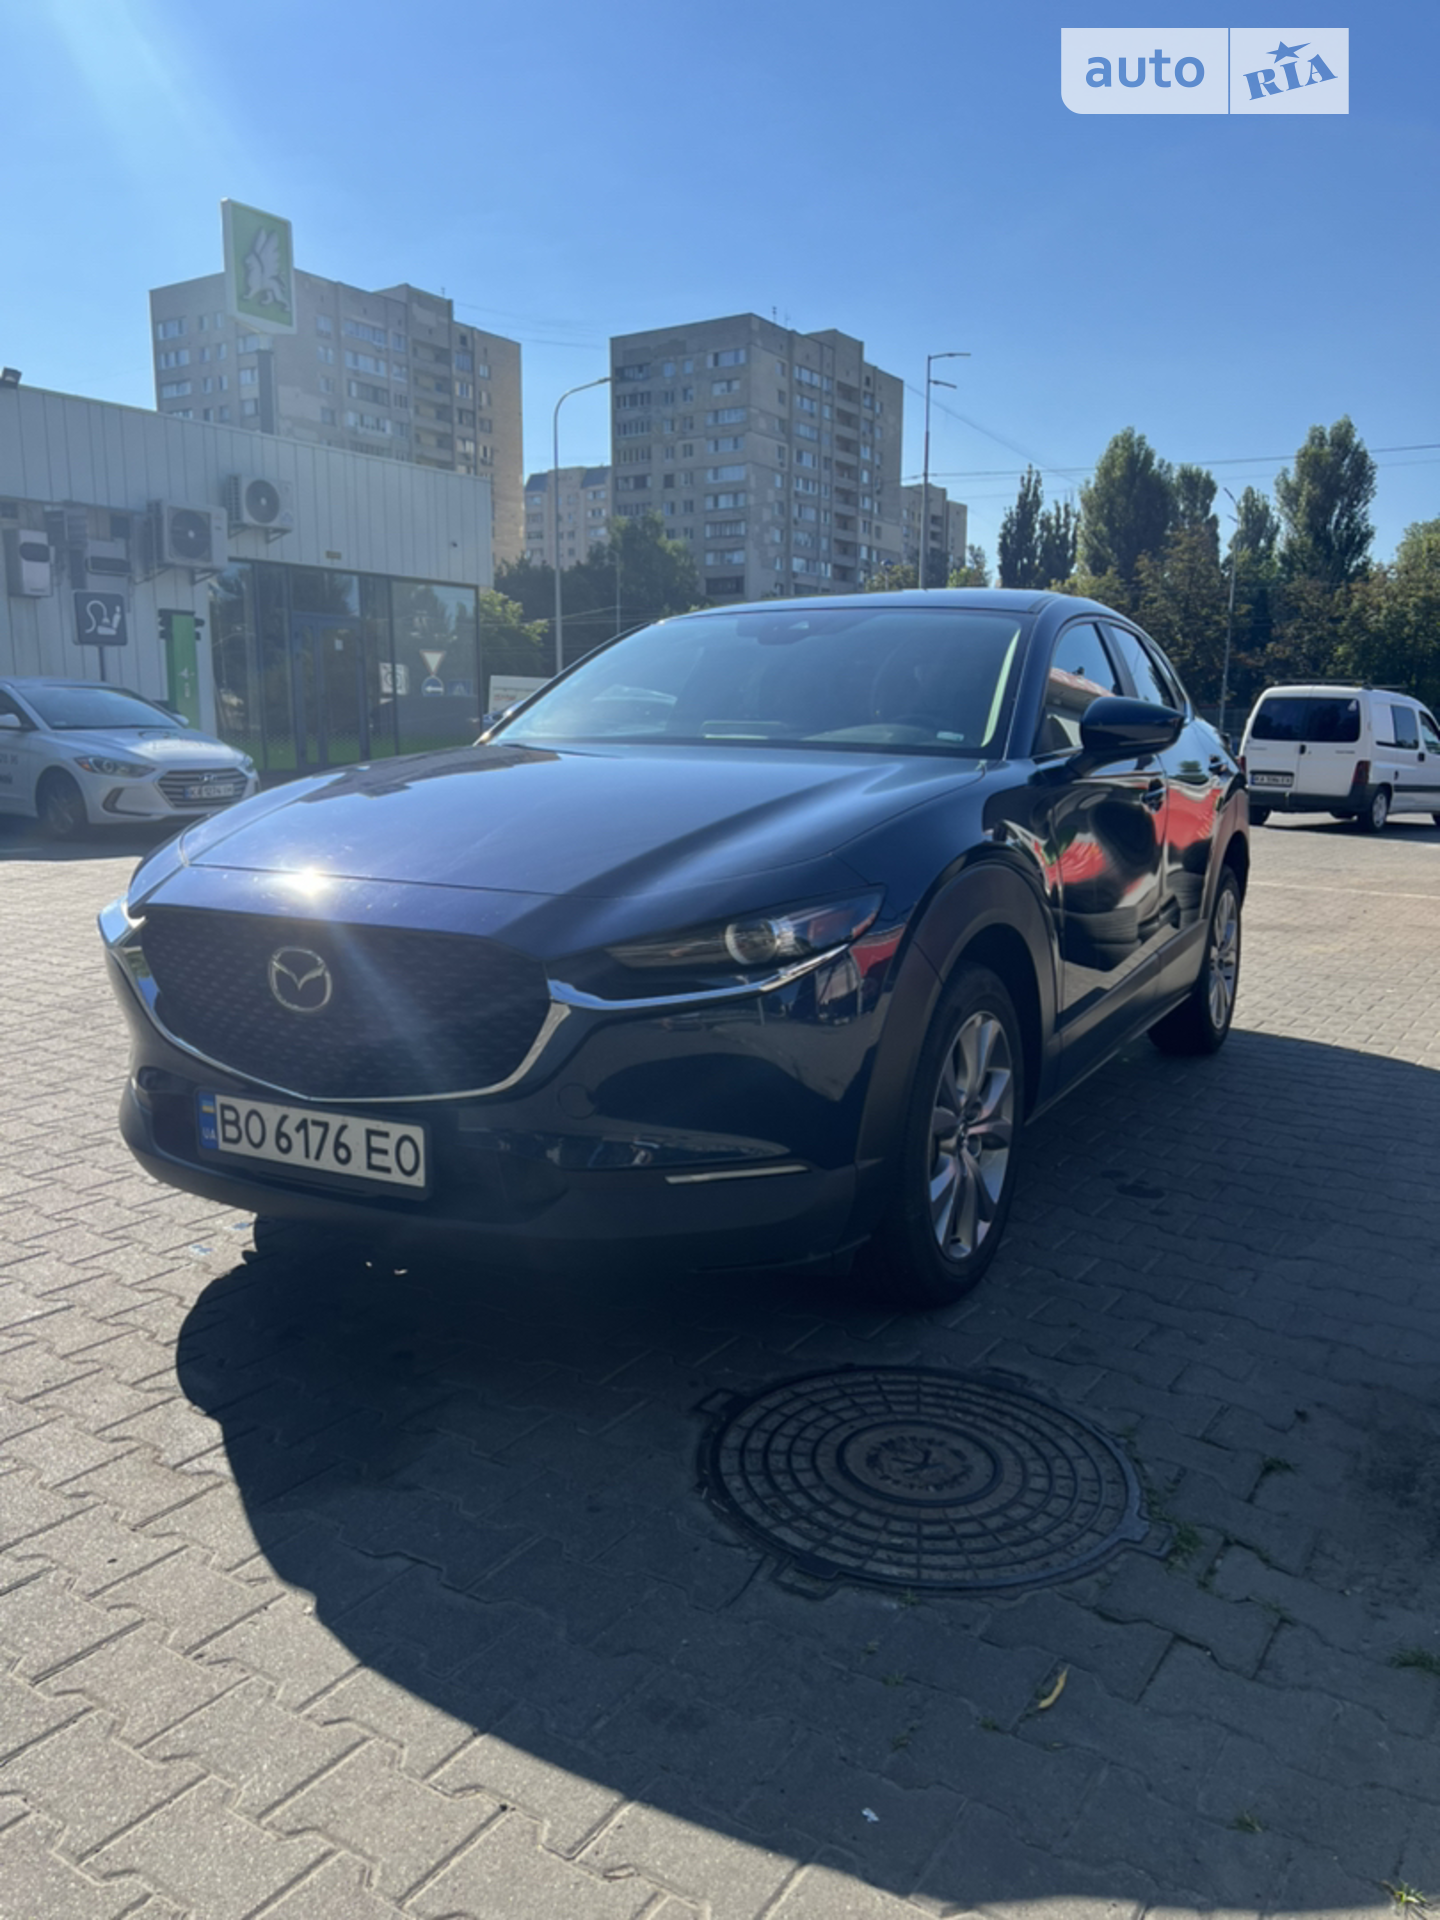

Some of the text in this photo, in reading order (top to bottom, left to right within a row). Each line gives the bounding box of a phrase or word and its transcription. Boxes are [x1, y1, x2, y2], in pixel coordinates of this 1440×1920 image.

[219, 1103, 420, 1177] BO 6176 EO
